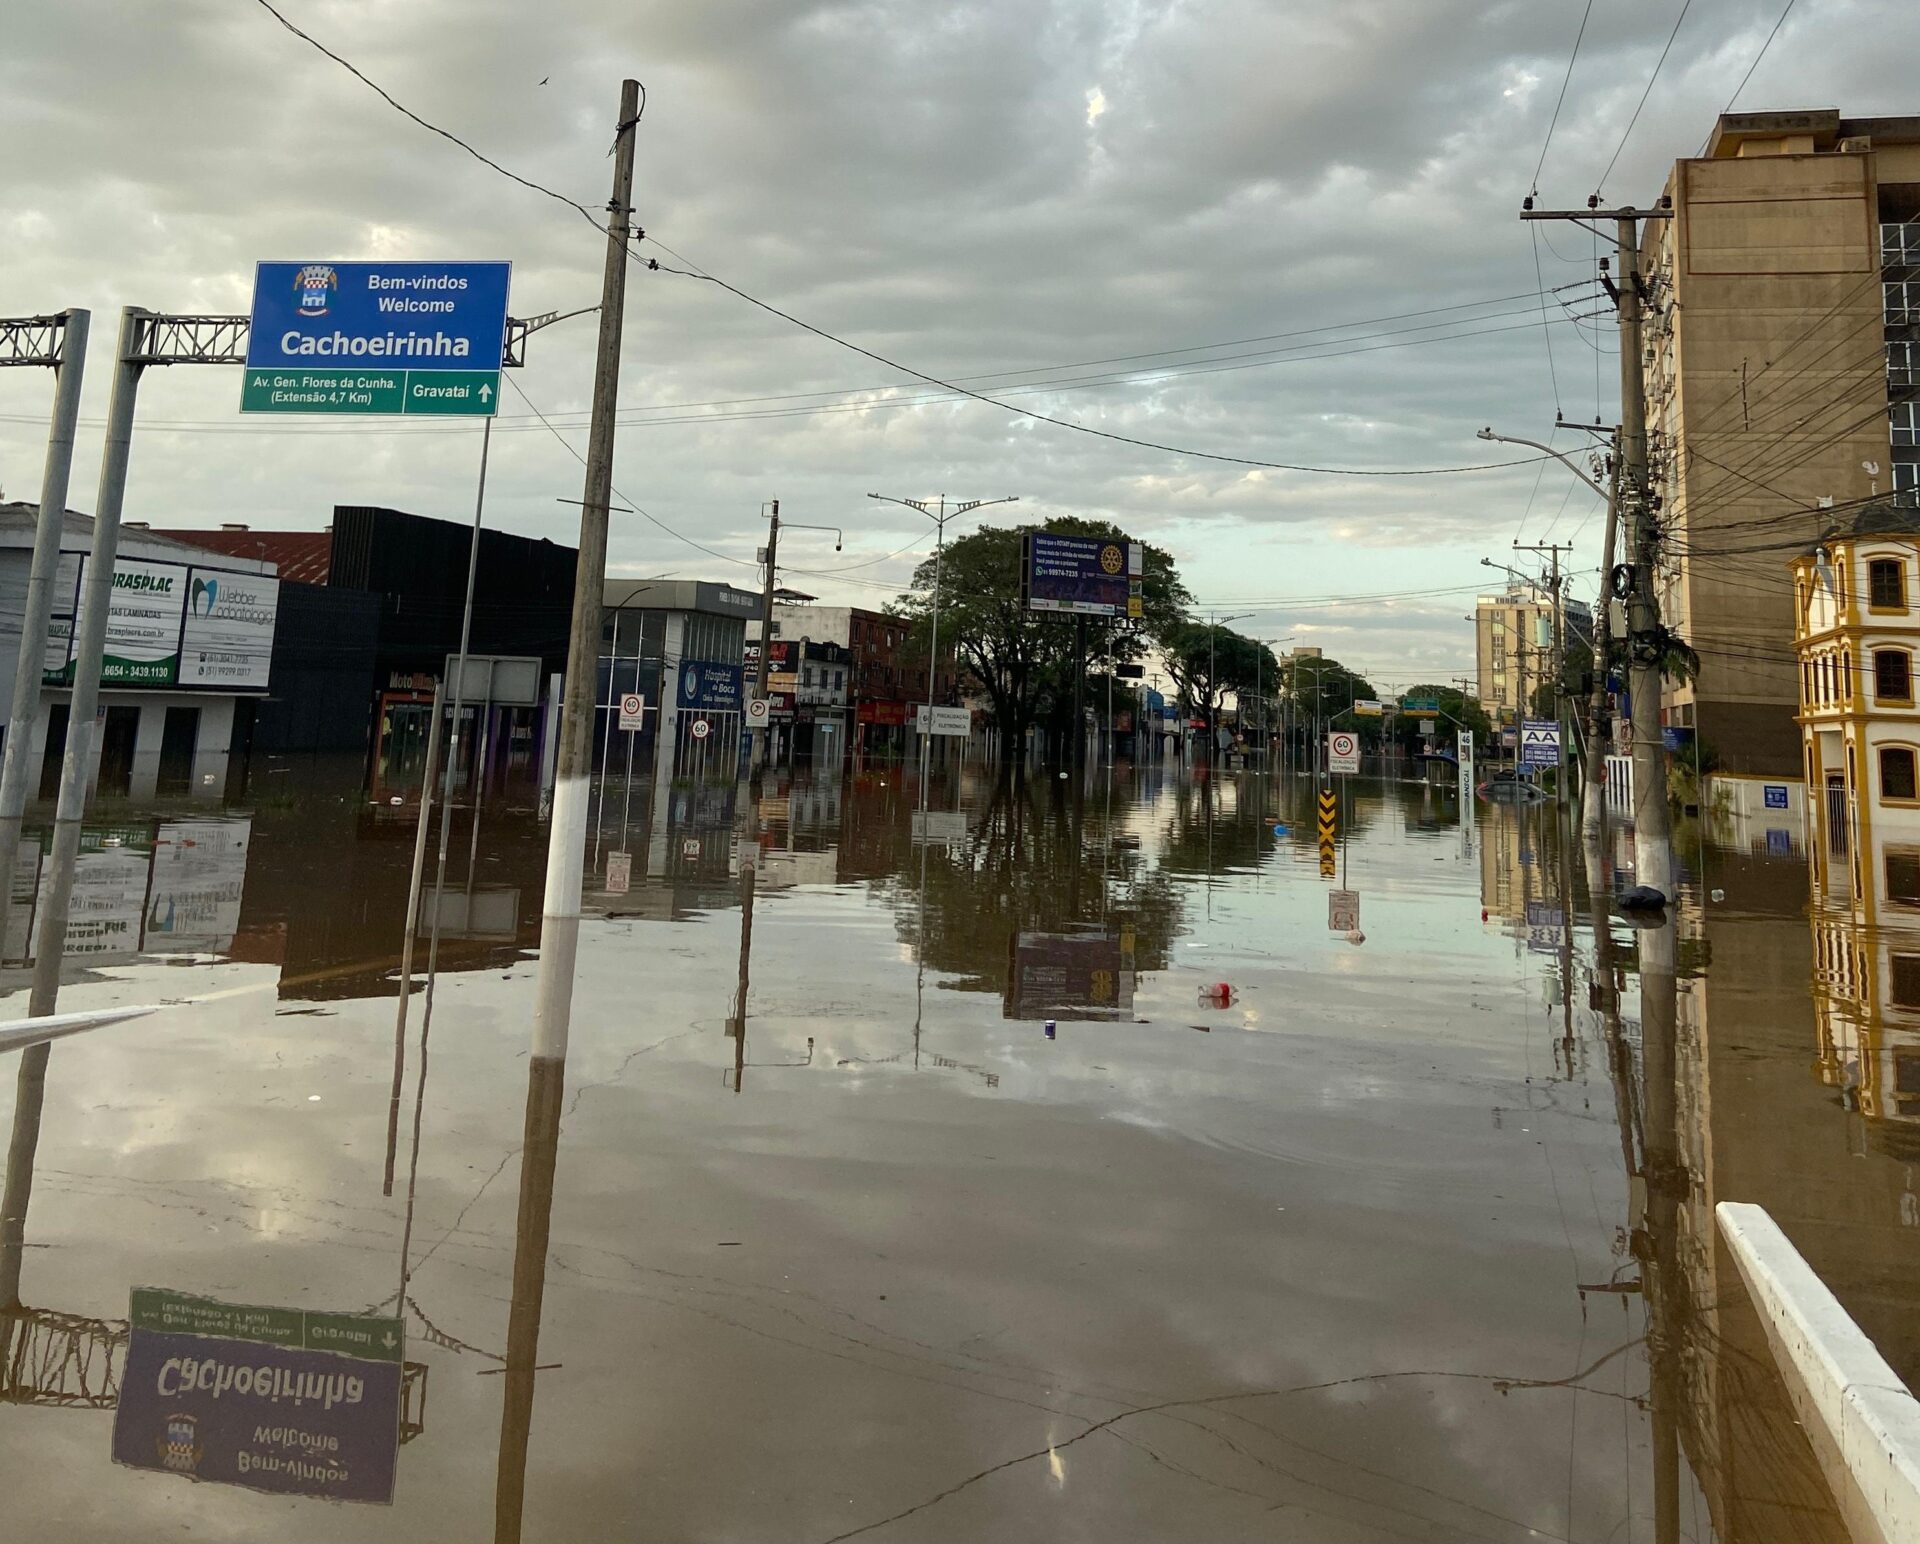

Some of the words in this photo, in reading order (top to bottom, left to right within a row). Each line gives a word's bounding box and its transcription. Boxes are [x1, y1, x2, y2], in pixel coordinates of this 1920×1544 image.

[368, 275, 468, 290] Bem-vindos
[379, 298, 455, 313] Welcome
[281, 331, 470, 357] Cachoeirinha
[253, 376, 271, 388] Av.
[273, 377, 299, 388] Gen.
[302, 377, 337, 389] Flores
[340, 377, 355, 389] da
[357, 377, 396, 390] Cunha.
[271, 391, 327, 406] (Extensão
[329, 392, 346, 406] 4,7
[349, 392, 372, 406] Km)
[413, 384, 470, 399] Gravataí
[218, 587, 257, 606] Webber
[704, 669, 731, 683] Hospital
[719, 683, 735, 694] Boca
[627, 700, 636, 708] 60
[695, 724, 706, 732] 60
[1337, 740, 1349, 748] 60
[1462, 735, 1470, 744] 46
[1526, 731, 1557, 743] AA
